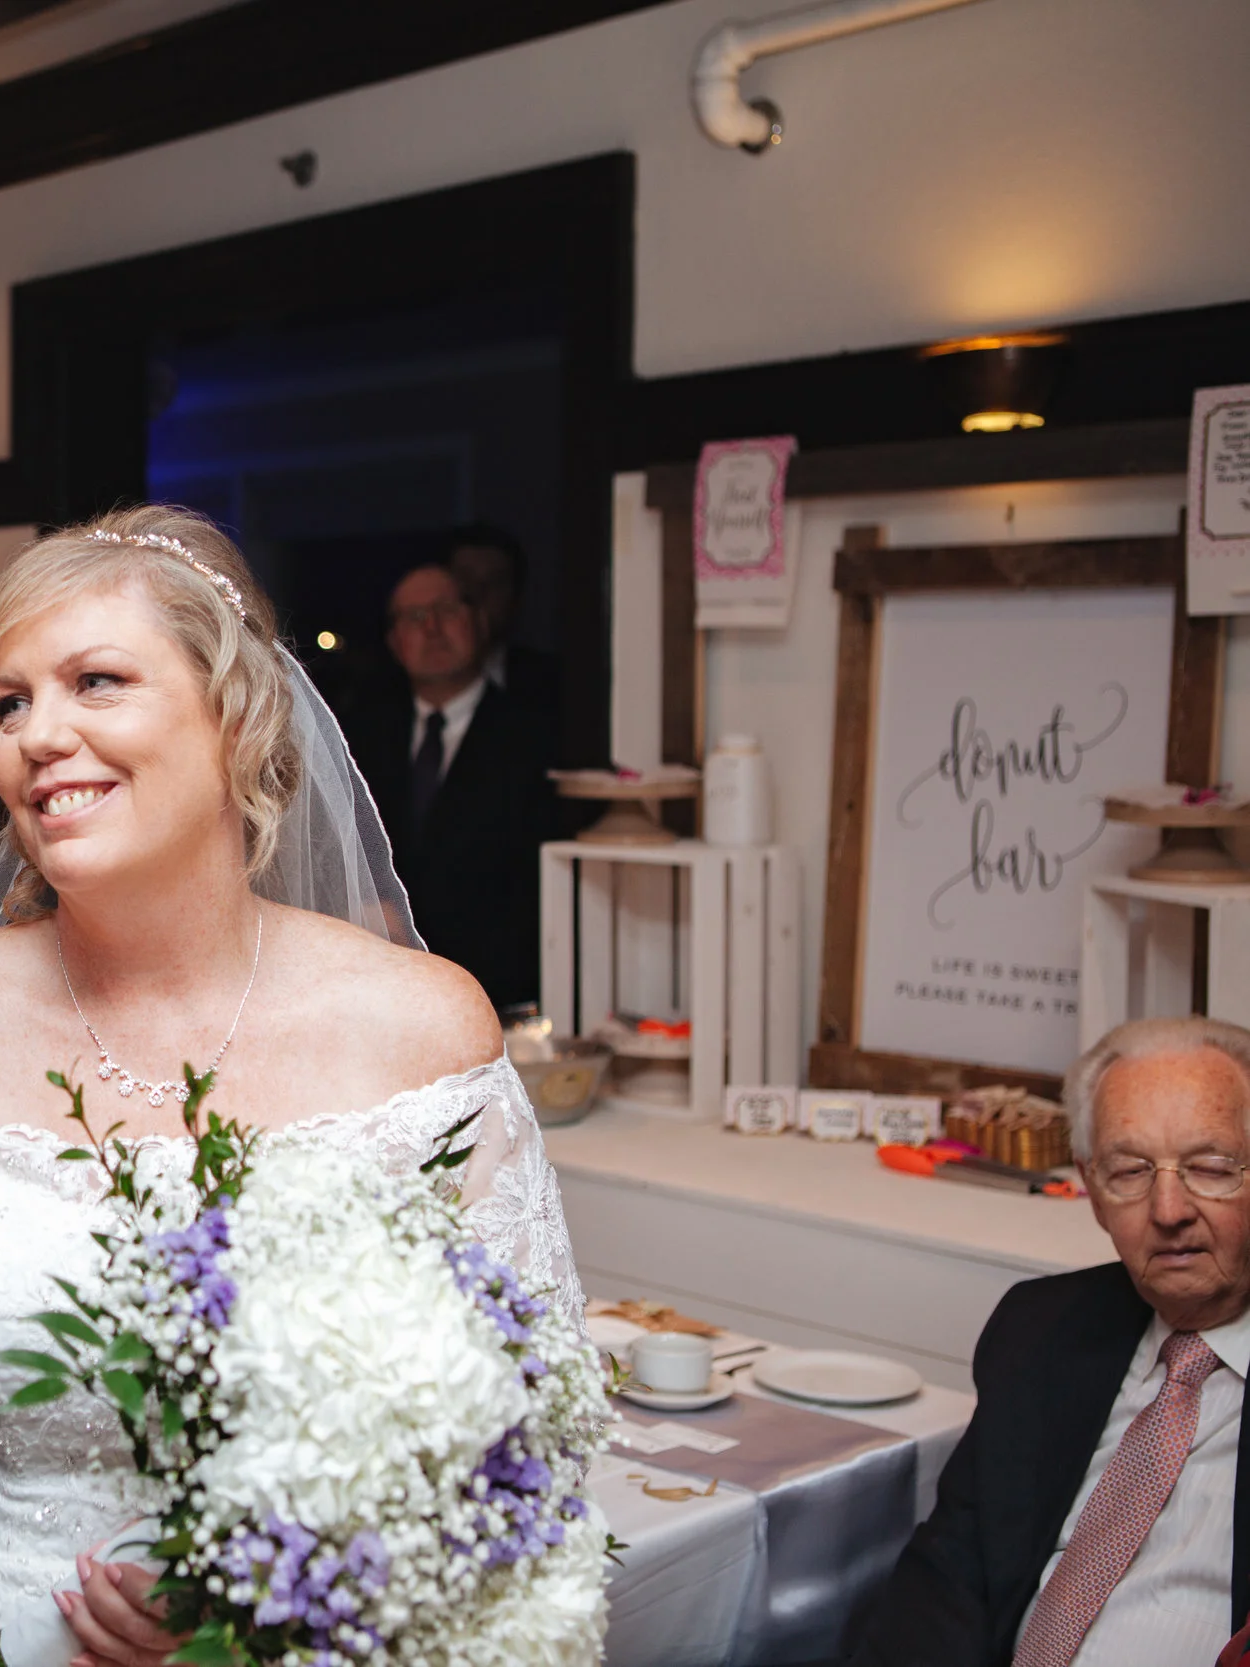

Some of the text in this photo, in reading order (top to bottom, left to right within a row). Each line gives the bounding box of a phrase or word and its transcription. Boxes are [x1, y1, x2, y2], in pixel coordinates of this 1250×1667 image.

[931, 956, 1080, 987] LIFE IS SWEET
[895, 980, 1079, 1018] PLEASE TAKE A TR
